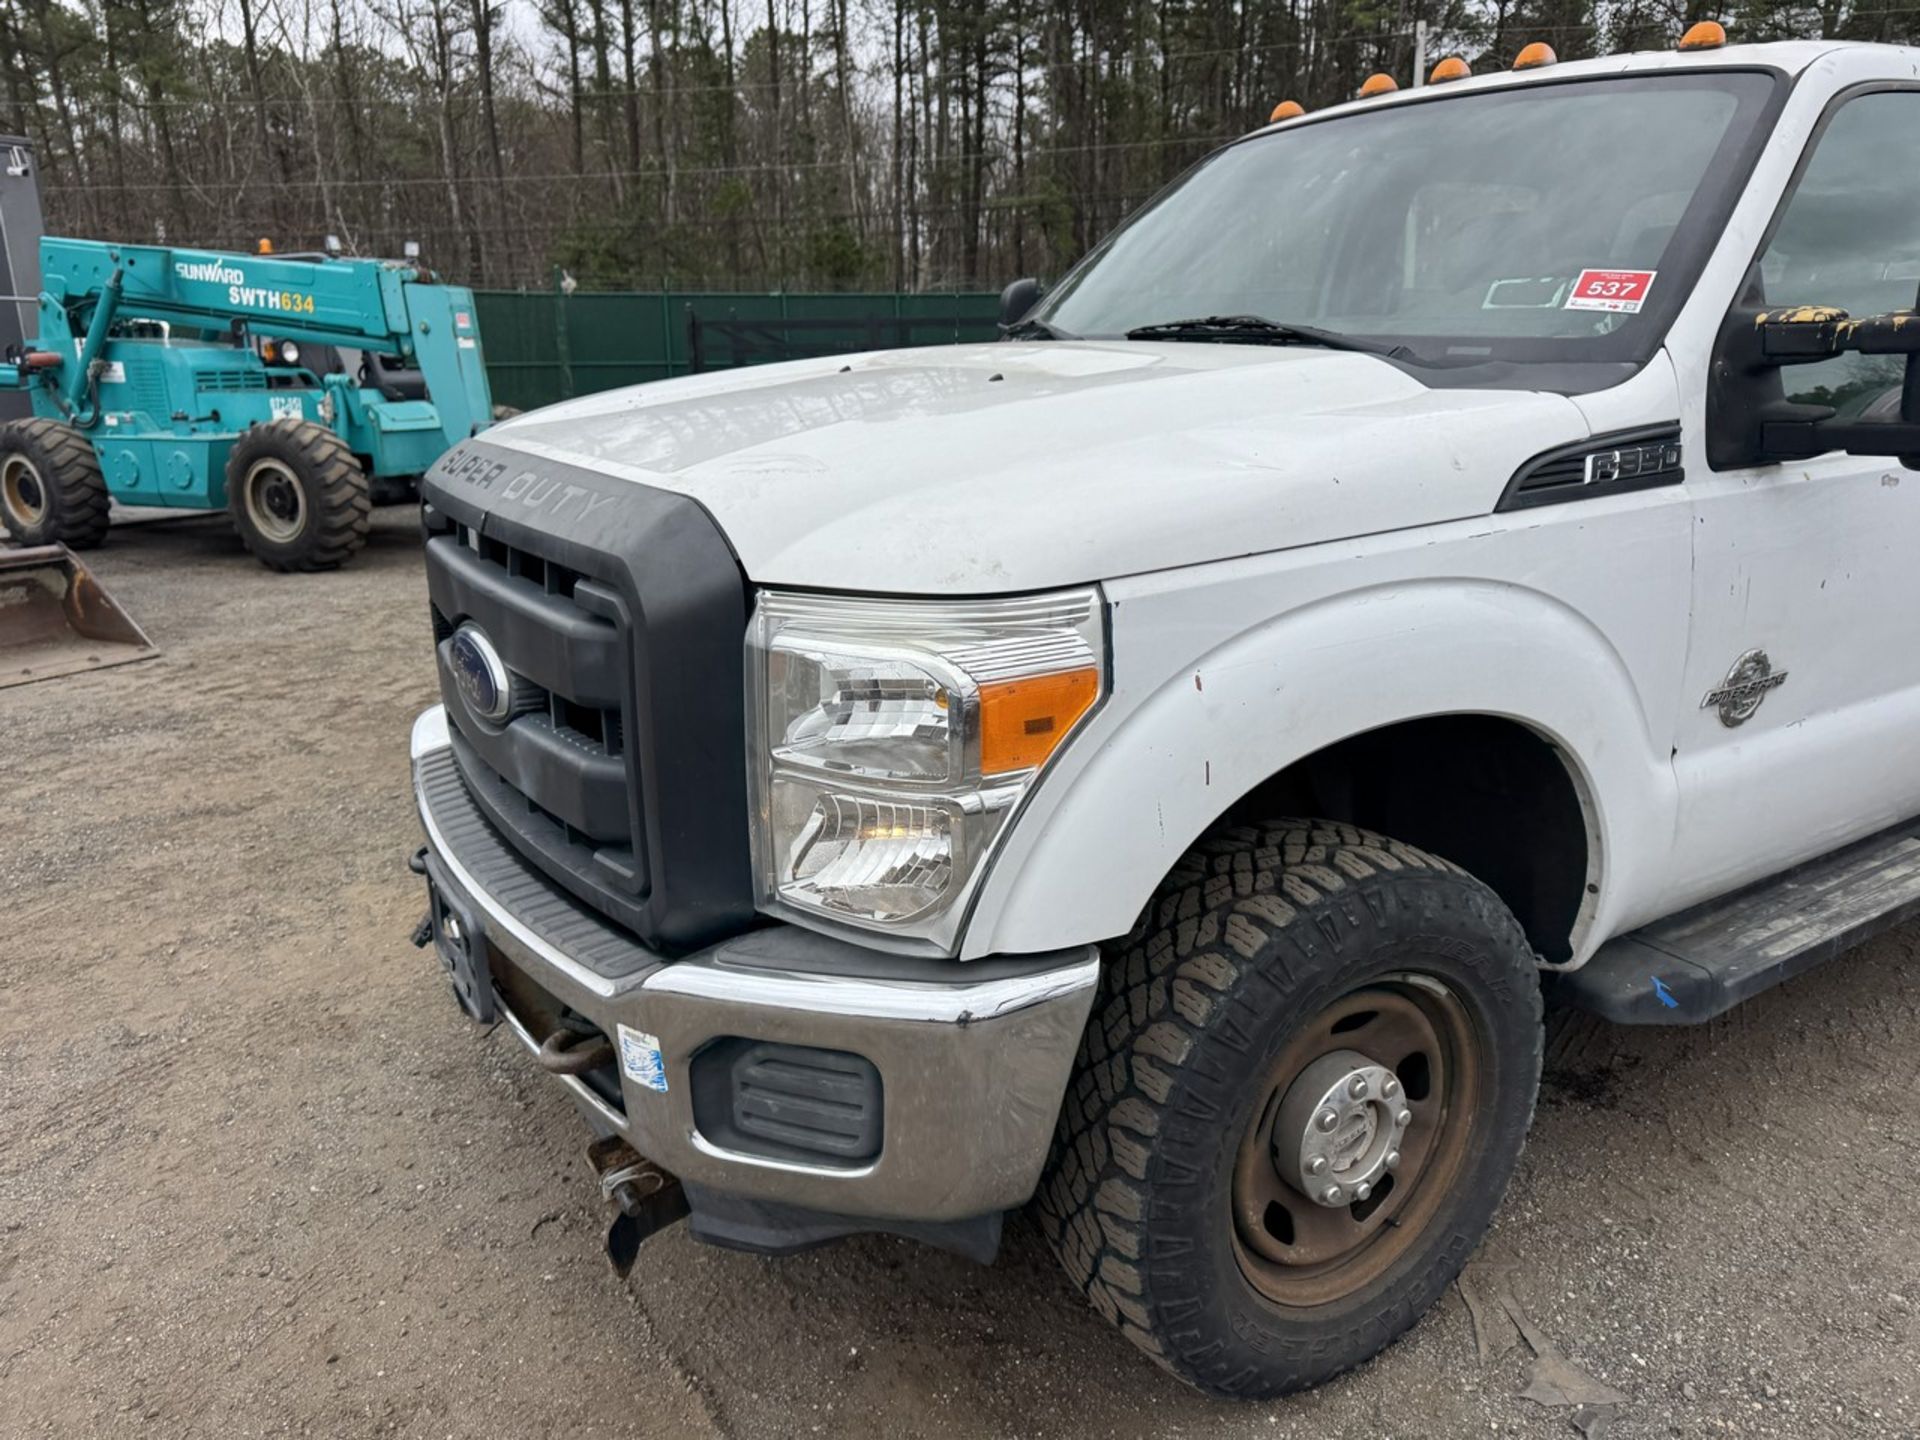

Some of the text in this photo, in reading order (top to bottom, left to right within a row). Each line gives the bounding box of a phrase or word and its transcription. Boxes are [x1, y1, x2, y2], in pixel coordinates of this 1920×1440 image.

[175, 258, 244, 285] SUNWARD
[229, 287, 314, 313] SWTH634
[1586, 281, 1639, 297] 537
[440, 448, 616, 522] SUPER DUTY
